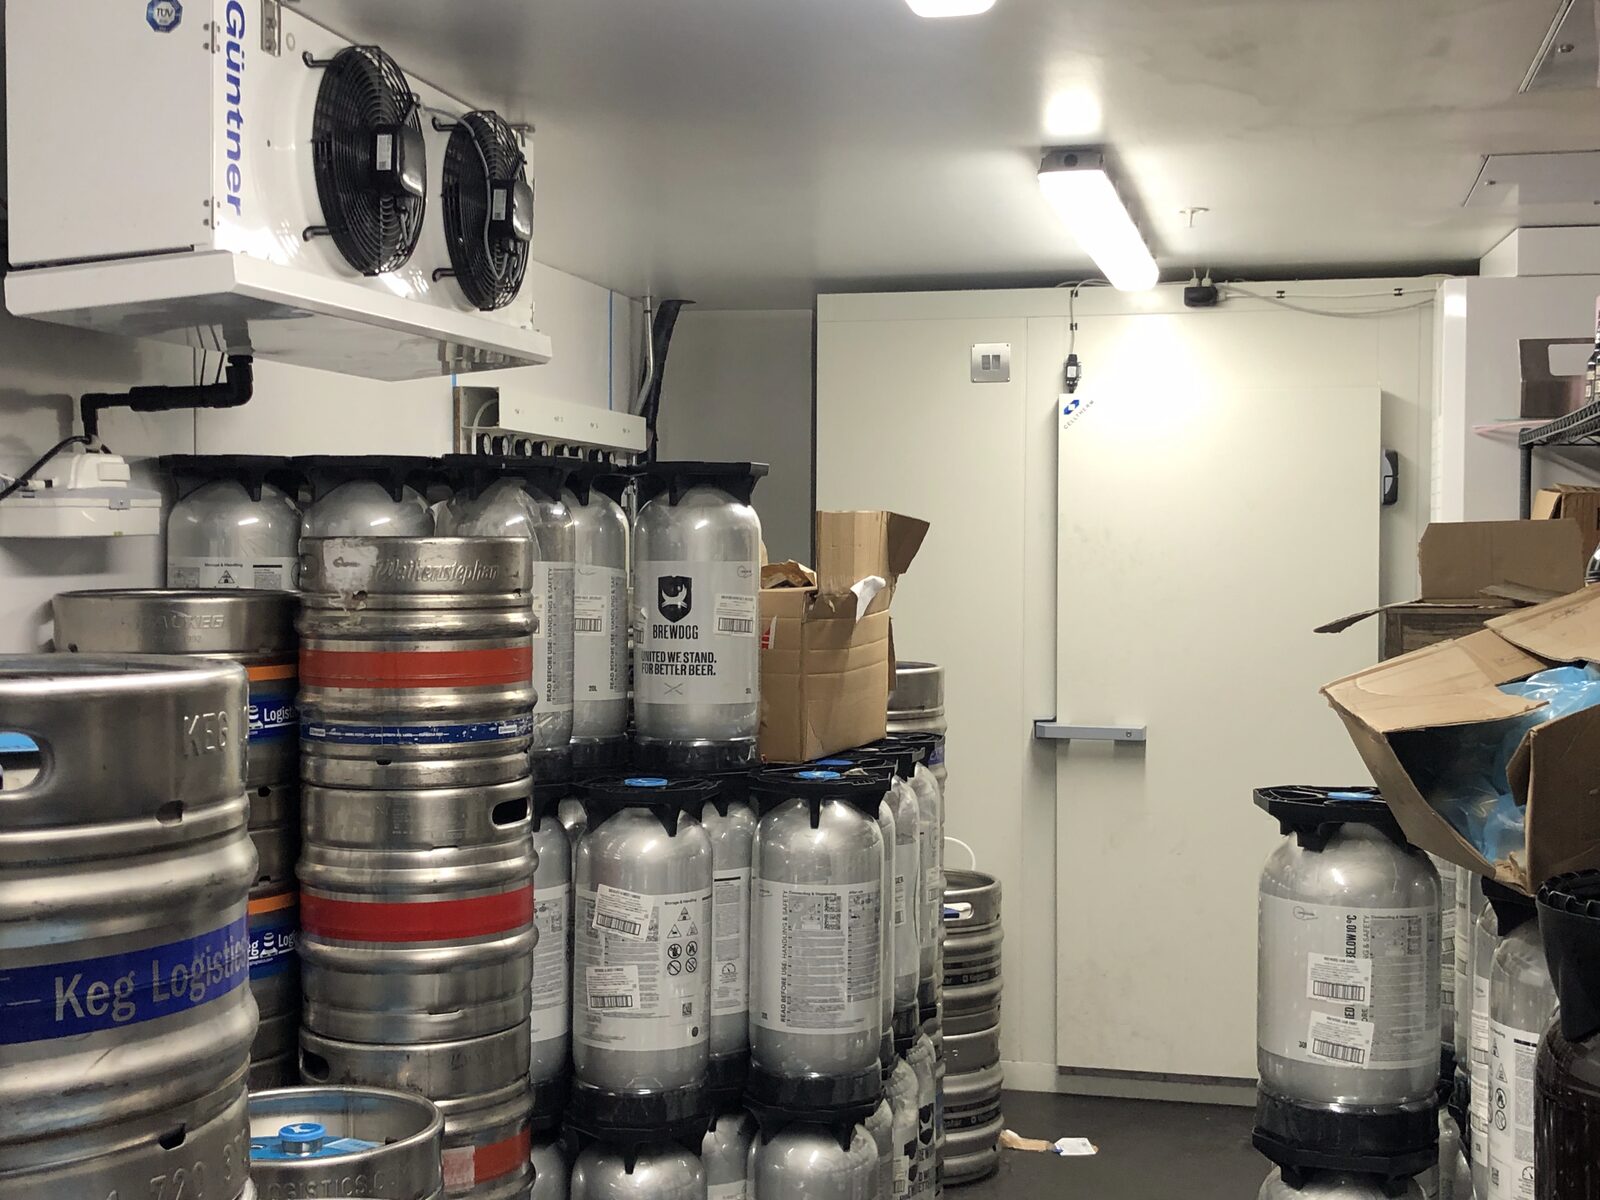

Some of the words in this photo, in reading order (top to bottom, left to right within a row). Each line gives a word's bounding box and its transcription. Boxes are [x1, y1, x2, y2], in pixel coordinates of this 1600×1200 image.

[226, 0, 246, 216] Güntner
[652, 624, 699, 640] BREWDOG
[640, 651, 667, 664] UNITED
[667, 651, 683, 664] WE
[683, 651, 717, 664] STAND.
[641, 663, 654, 675] FOR
[654, 663, 687, 676] BETTER
[688, 663, 717, 676] BEER.
[183, 710, 229, 759] KEG
[54, 969, 136, 1023] Keg
